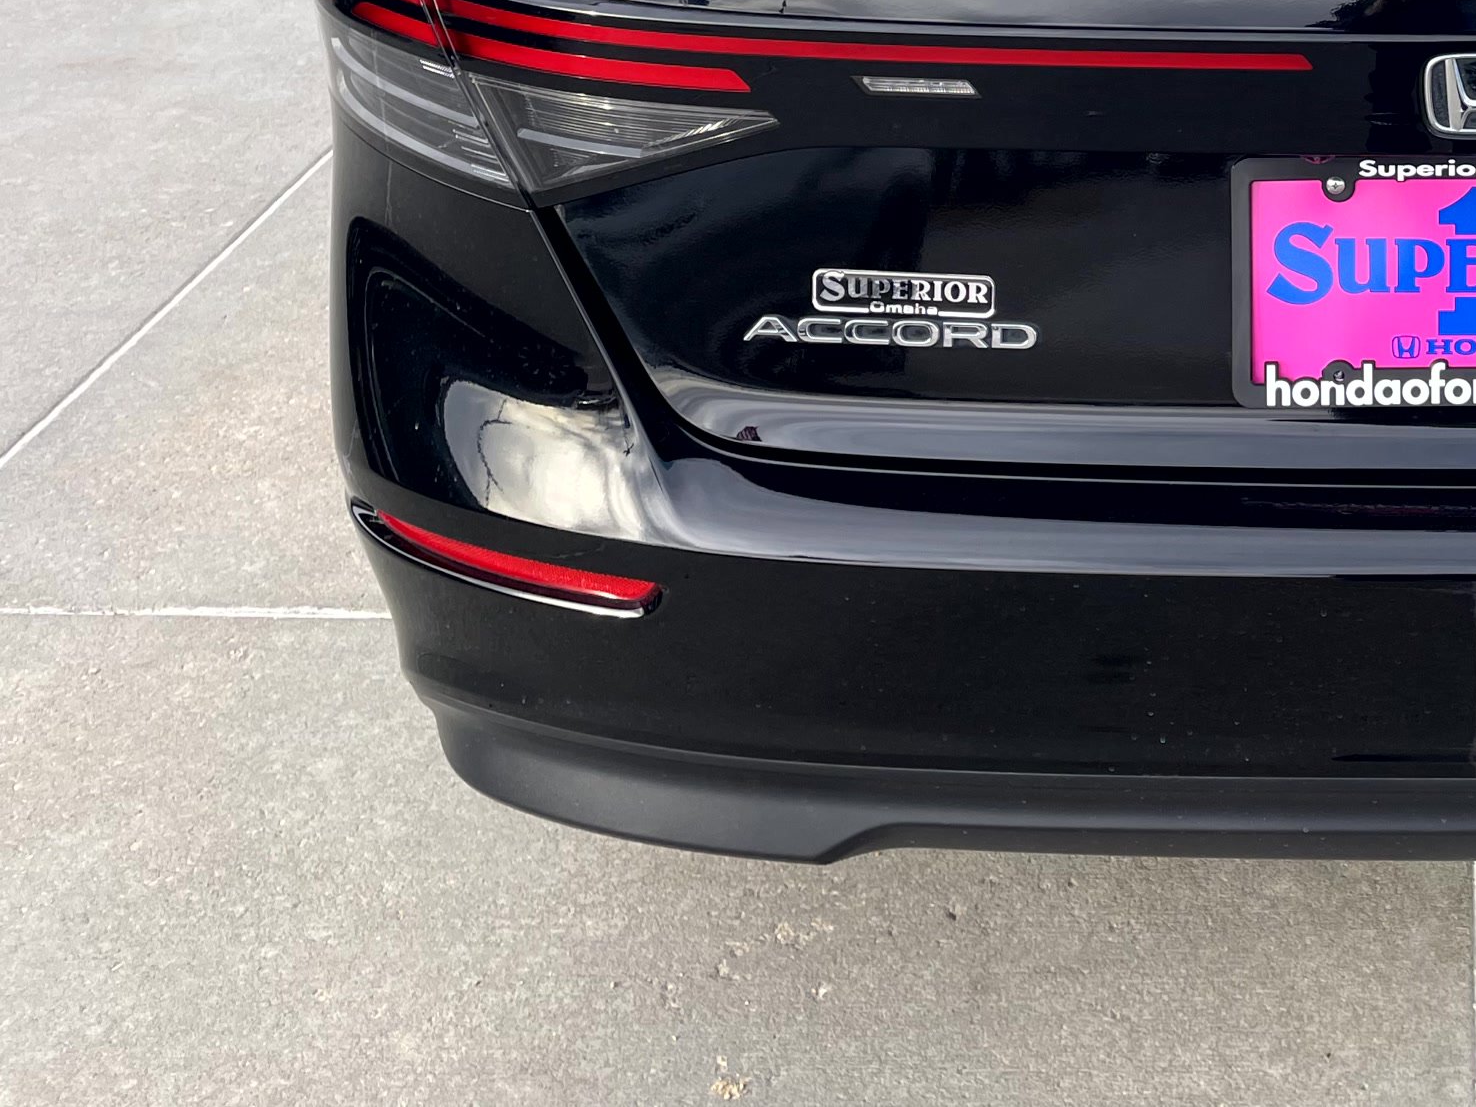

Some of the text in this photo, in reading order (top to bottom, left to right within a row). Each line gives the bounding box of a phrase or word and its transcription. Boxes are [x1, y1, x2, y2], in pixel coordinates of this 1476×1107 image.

[820, 269, 988, 304] SUPERIOR
[869, 301, 939, 316] Omaha
[743, 315, 1037, 350] ACCORD
